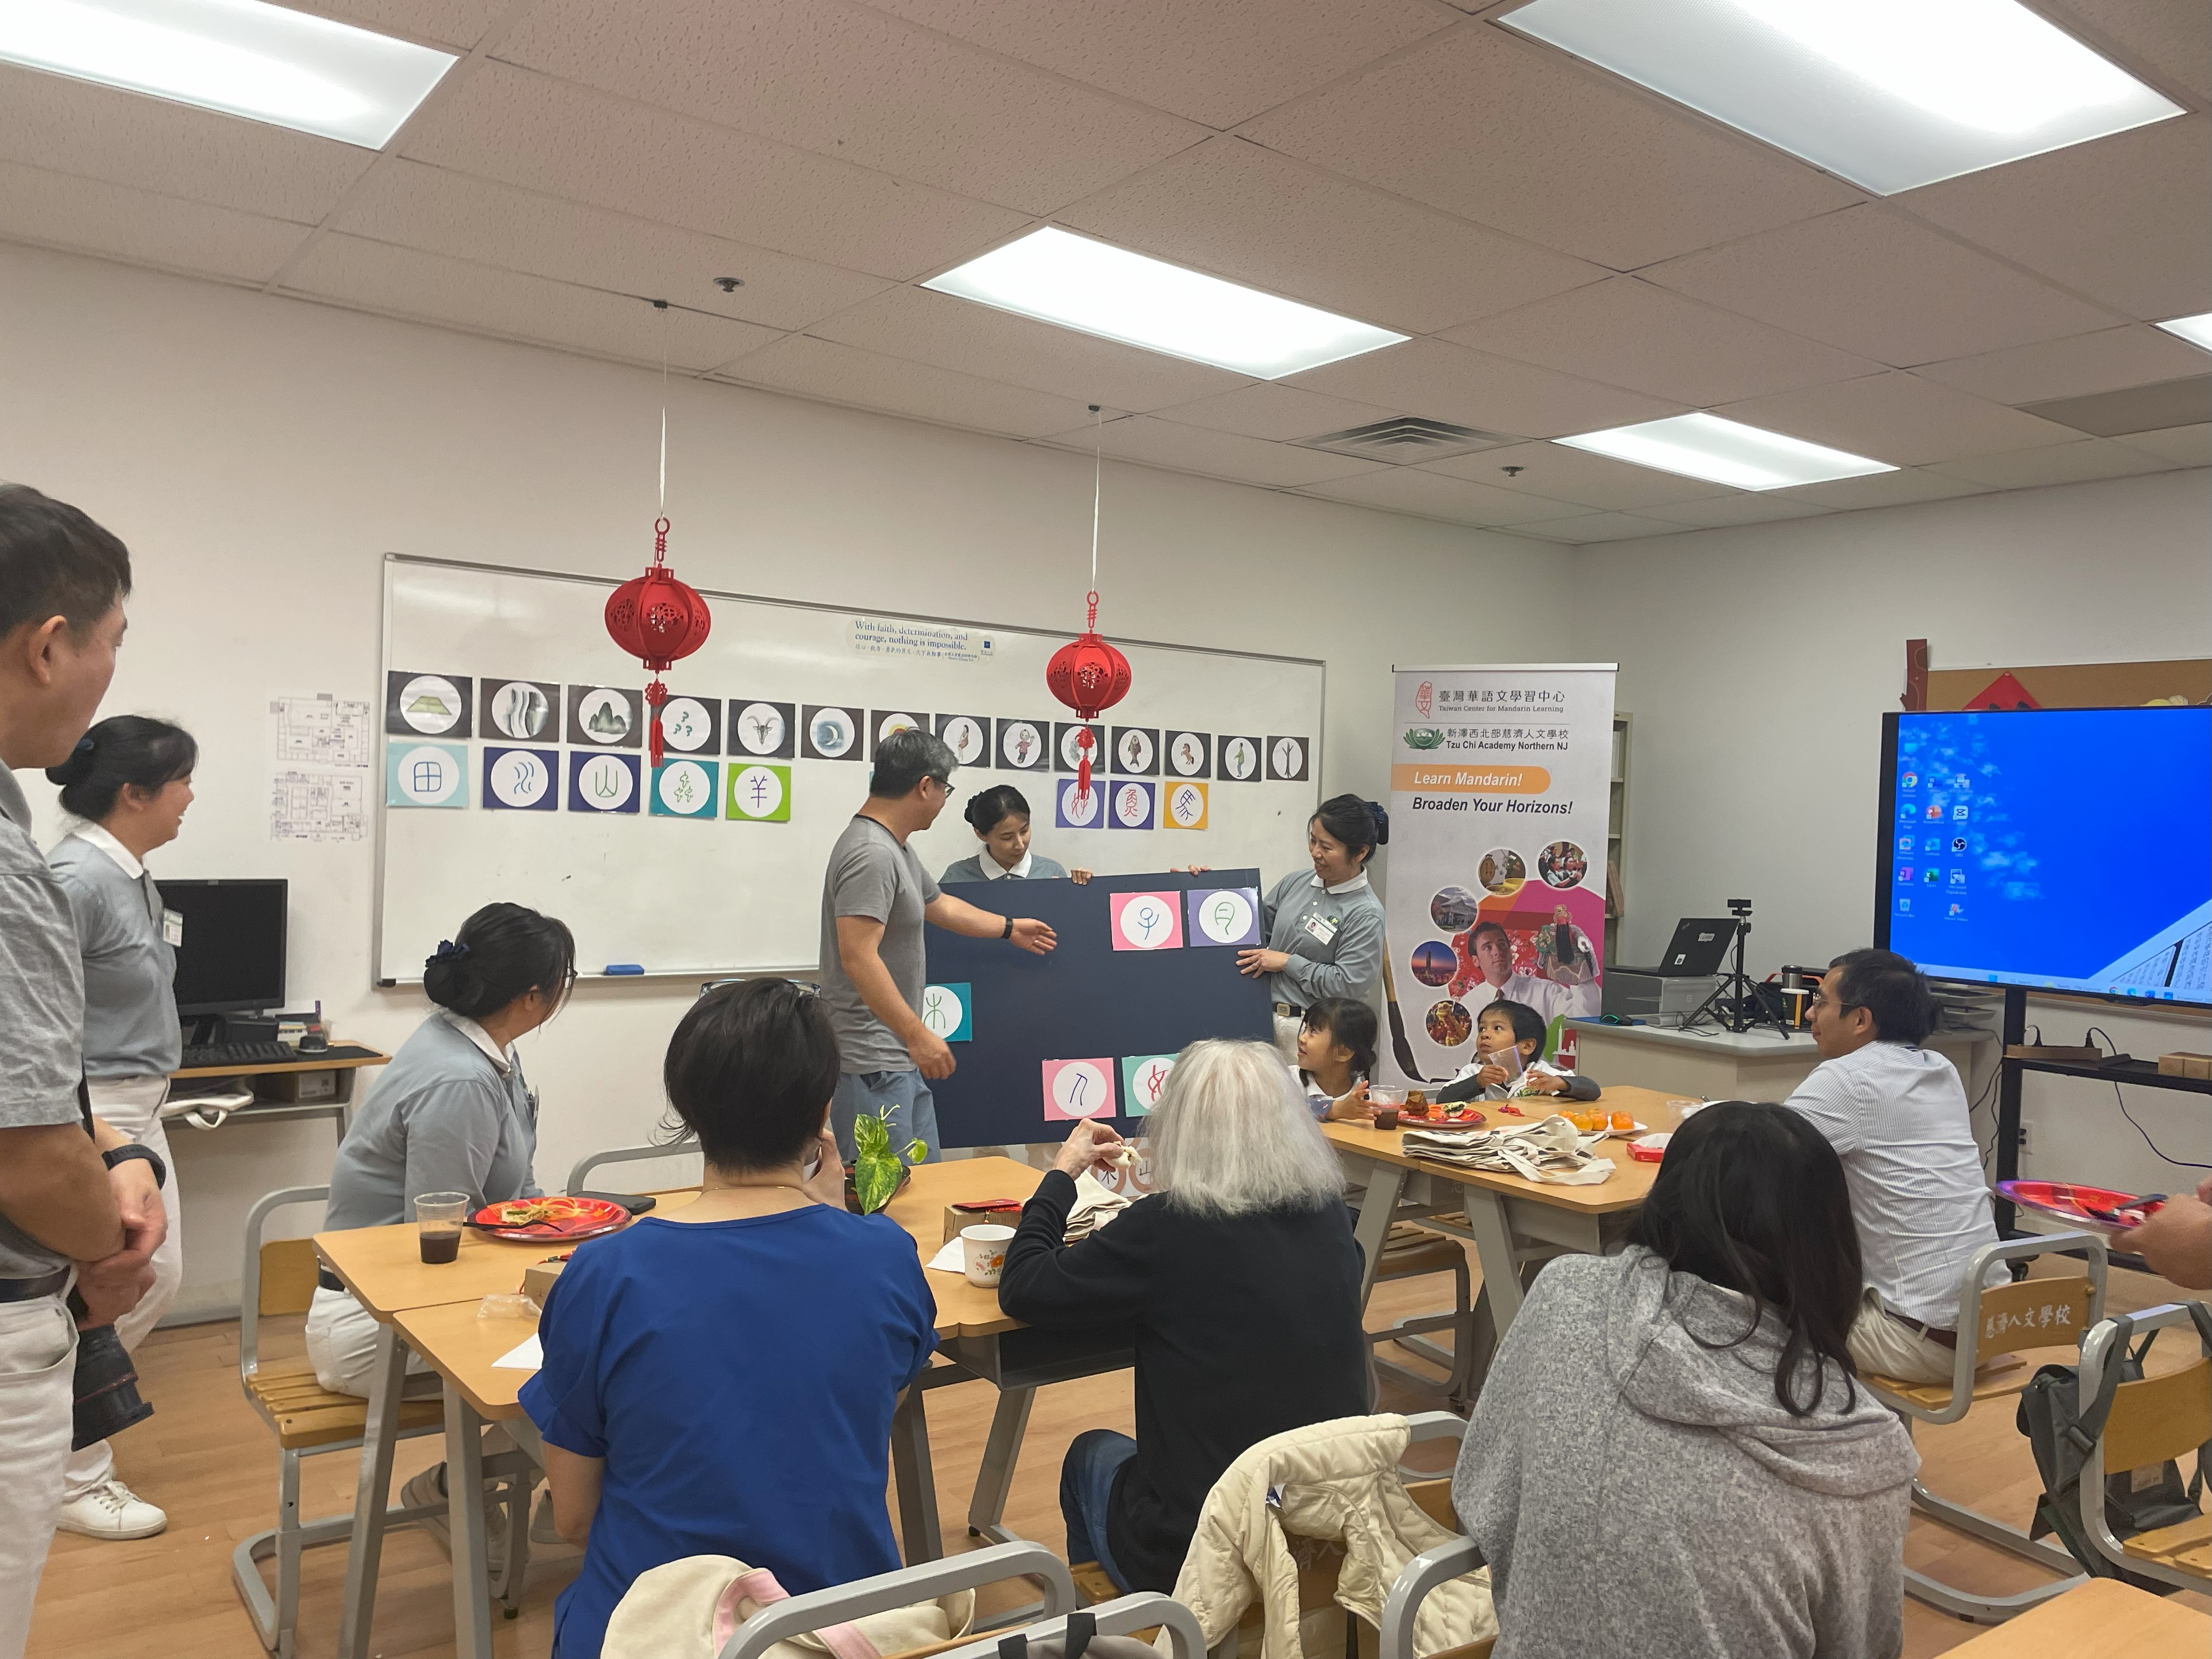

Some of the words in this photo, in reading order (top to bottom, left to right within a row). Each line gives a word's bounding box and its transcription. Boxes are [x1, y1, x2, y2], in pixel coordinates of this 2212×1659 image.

[855, 621, 874, 631] With
[877, 623, 897, 634] faith,
[899, 626, 952, 640] determination,
[954, 632, 968, 641] and
[855, 634, 887, 644] courage,
[889, 635, 918, 647] nothing
[919, 639, 926, 647] is
[927, 639, 967, 651] impossible.
[1438, 690, 1565, 703] 臺灣華語文學習中心
[1447, 727, 1569, 740] 新澤西北部慈濟人文學校
[1446, 741, 1460, 749] Tzu
[1463, 741, 1476, 749] Chi
[1478, 741, 1517, 751] Academy
[1518, 742, 1554, 750] Northern
[1414, 771, 1452, 785] Learn
[1455, 772, 1523, 787] Mandarin!
[1412, 797, 1468, 811] Broaden
[1473, 798, 1503, 812] Your
[1506, 800, 1573, 814] Horizons!
